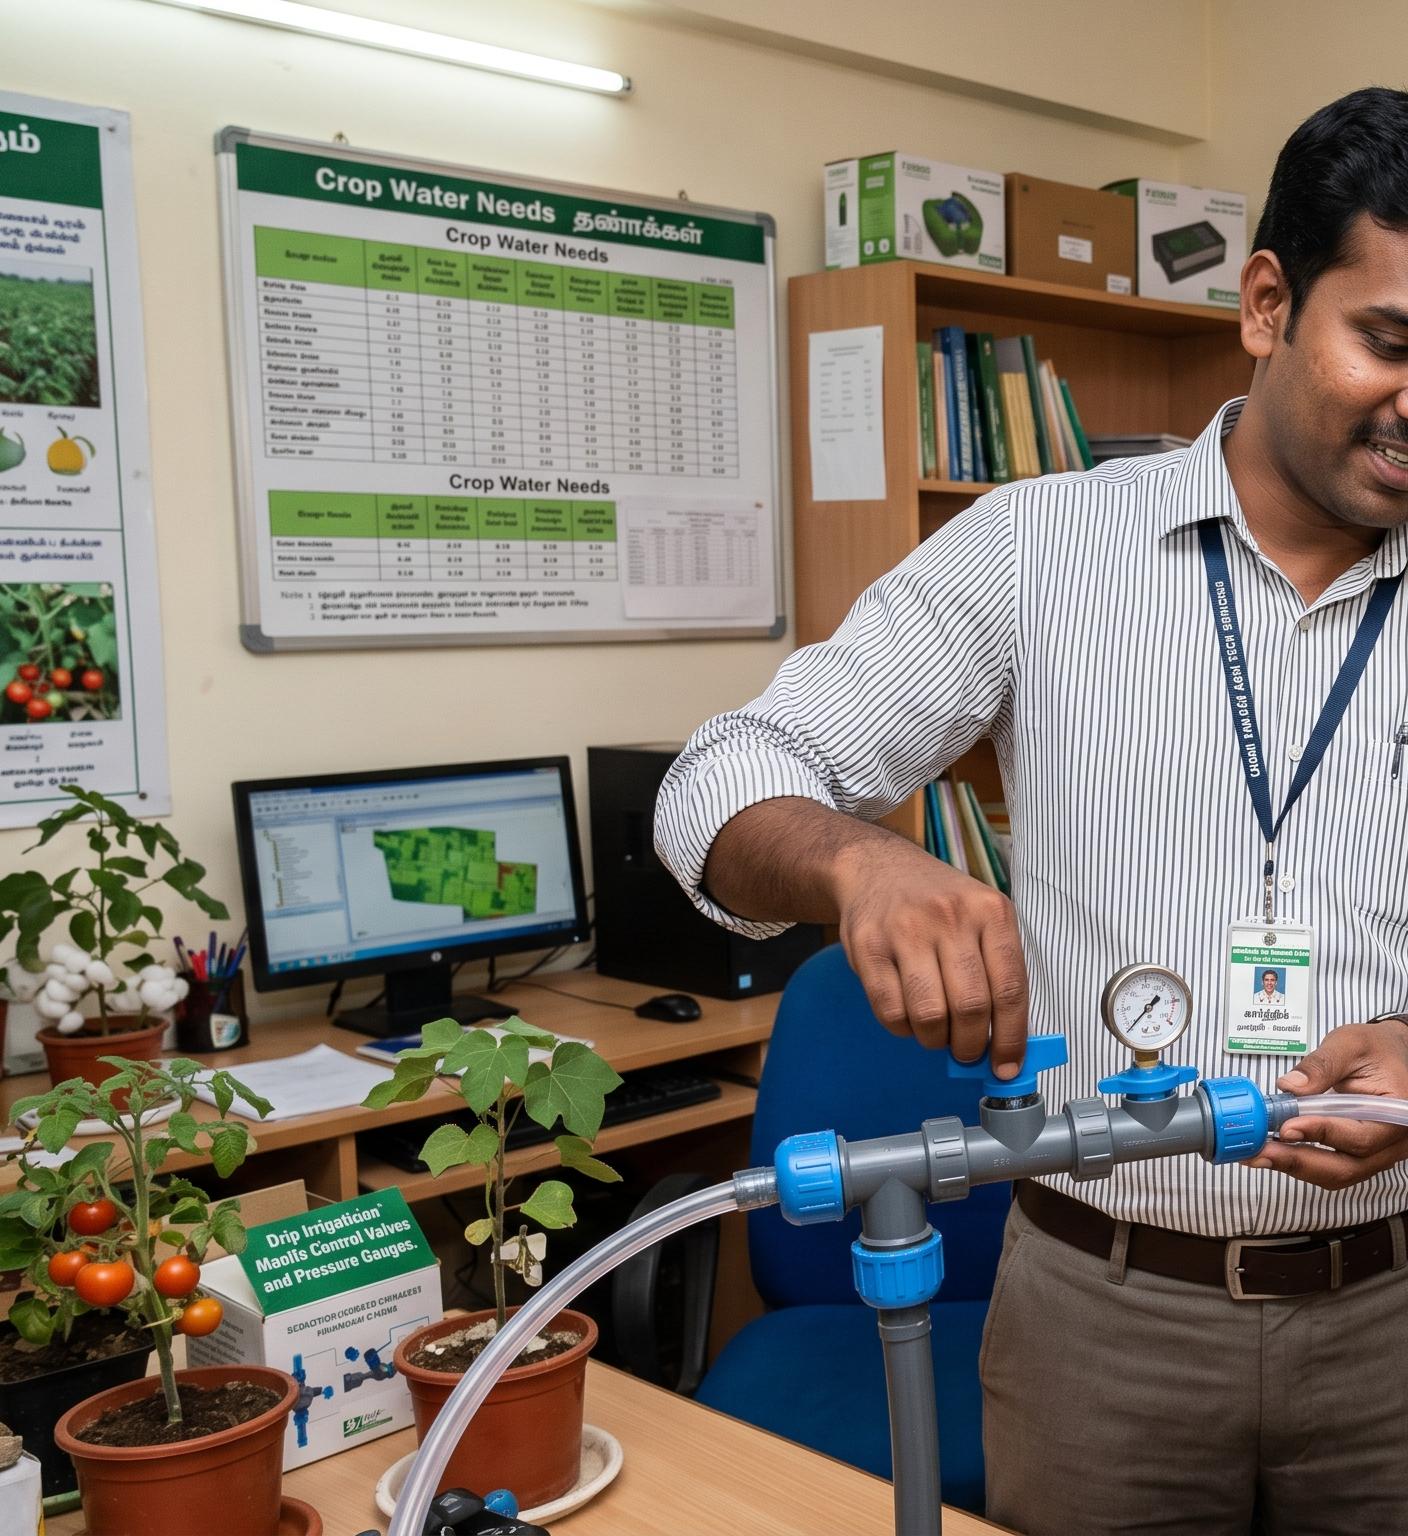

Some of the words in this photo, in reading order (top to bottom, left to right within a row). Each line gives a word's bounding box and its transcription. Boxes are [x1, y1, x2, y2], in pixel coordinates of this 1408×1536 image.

[315, 167, 383, 201] Crop
[390, 176, 470, 210] Water
[476, 191, 557, 224] Needs
[445, 227, 492, 251] Crop
[497, 234, 551, 257] Water
[554, 242, 610, 265] Needs
[449, 473, 496, 495] Crop
[499, 476, 553, 494] Water
[557, 477, 611, 496] Needs
[265, 1229, 301, 1249] Drip
[367, 1218, 411, 1241] Valves
[263, 1273, 293, 1293] and
[294, 1252, 360, 1283] Pressure
[361, 1240, 418, 1264] Gauges.
